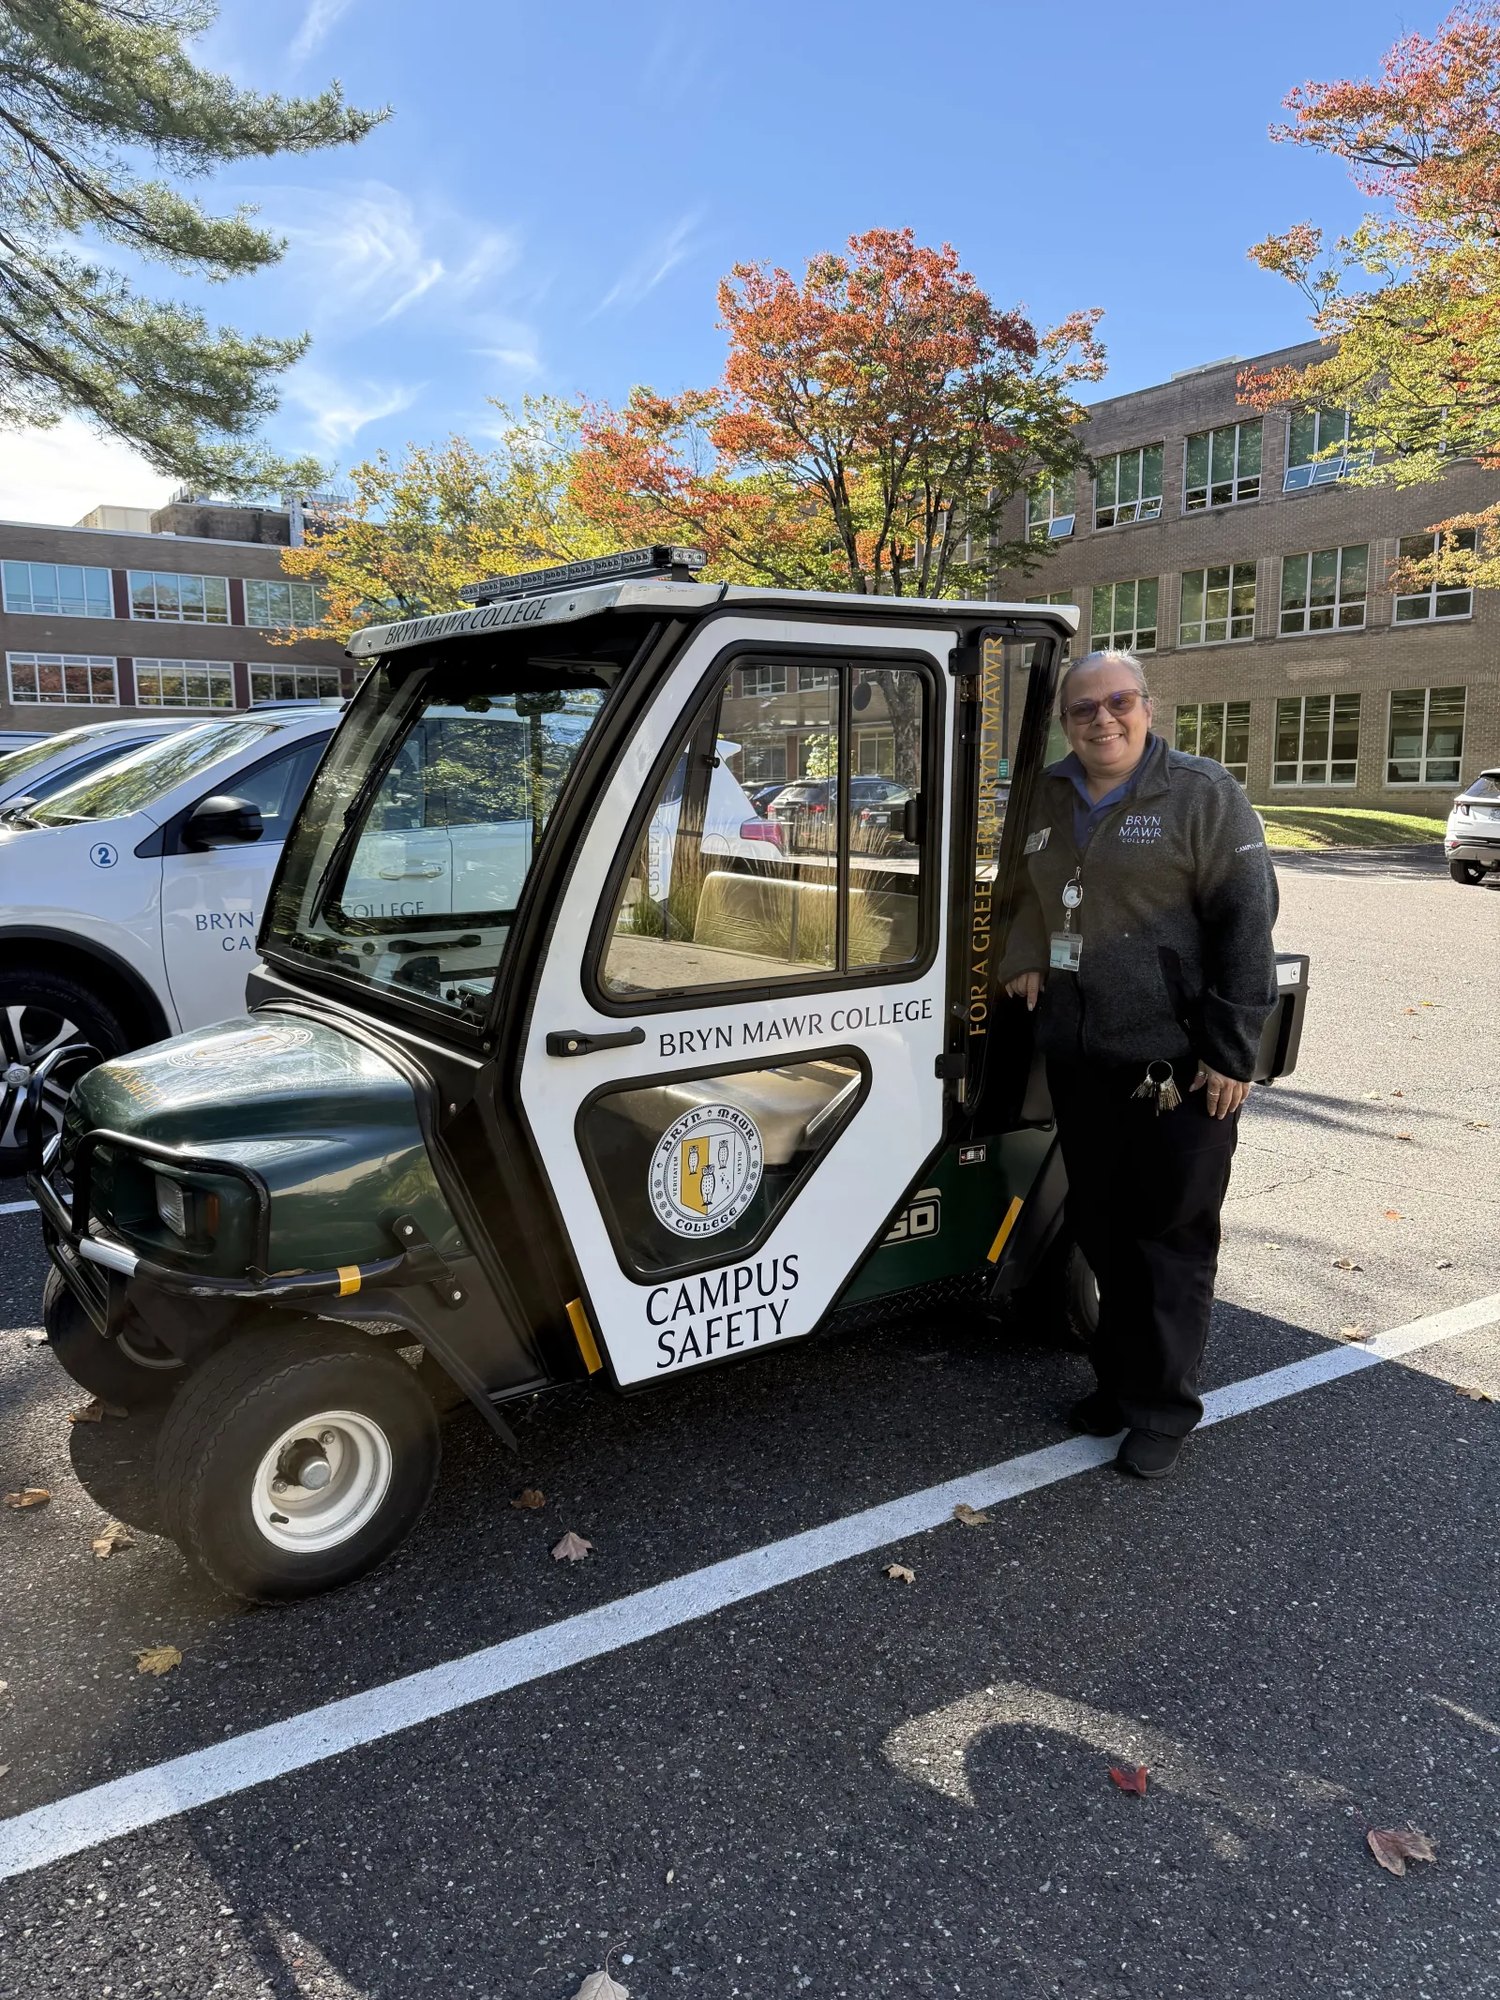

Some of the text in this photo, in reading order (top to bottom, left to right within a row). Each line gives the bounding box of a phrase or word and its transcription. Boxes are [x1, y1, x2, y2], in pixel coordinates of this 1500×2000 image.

[384, 597, 552, 645] BRYN MAWR COLLEGE
[969, 635, 1003, 1036] FOR A GREENER BRYN MAWR
[1118, 827, 1162, 838] MAWR
[1125, 815, 1161, 826] BRYN
[98, 847, 111, 864] 2
[195, 911, 254, 931] BRYN
[222, 935, 258, 951] CA
[659, 998, 933, 1057] BRYN MAWR COLLEGE
[661, 1108, 755, 1153] BRYN MAWR
[675, 1206, 738, 1232] COLLEGE
[645, 1254, 799, 1326] CAMPUS
[656, 1298, 790, 1369] SAFETY
